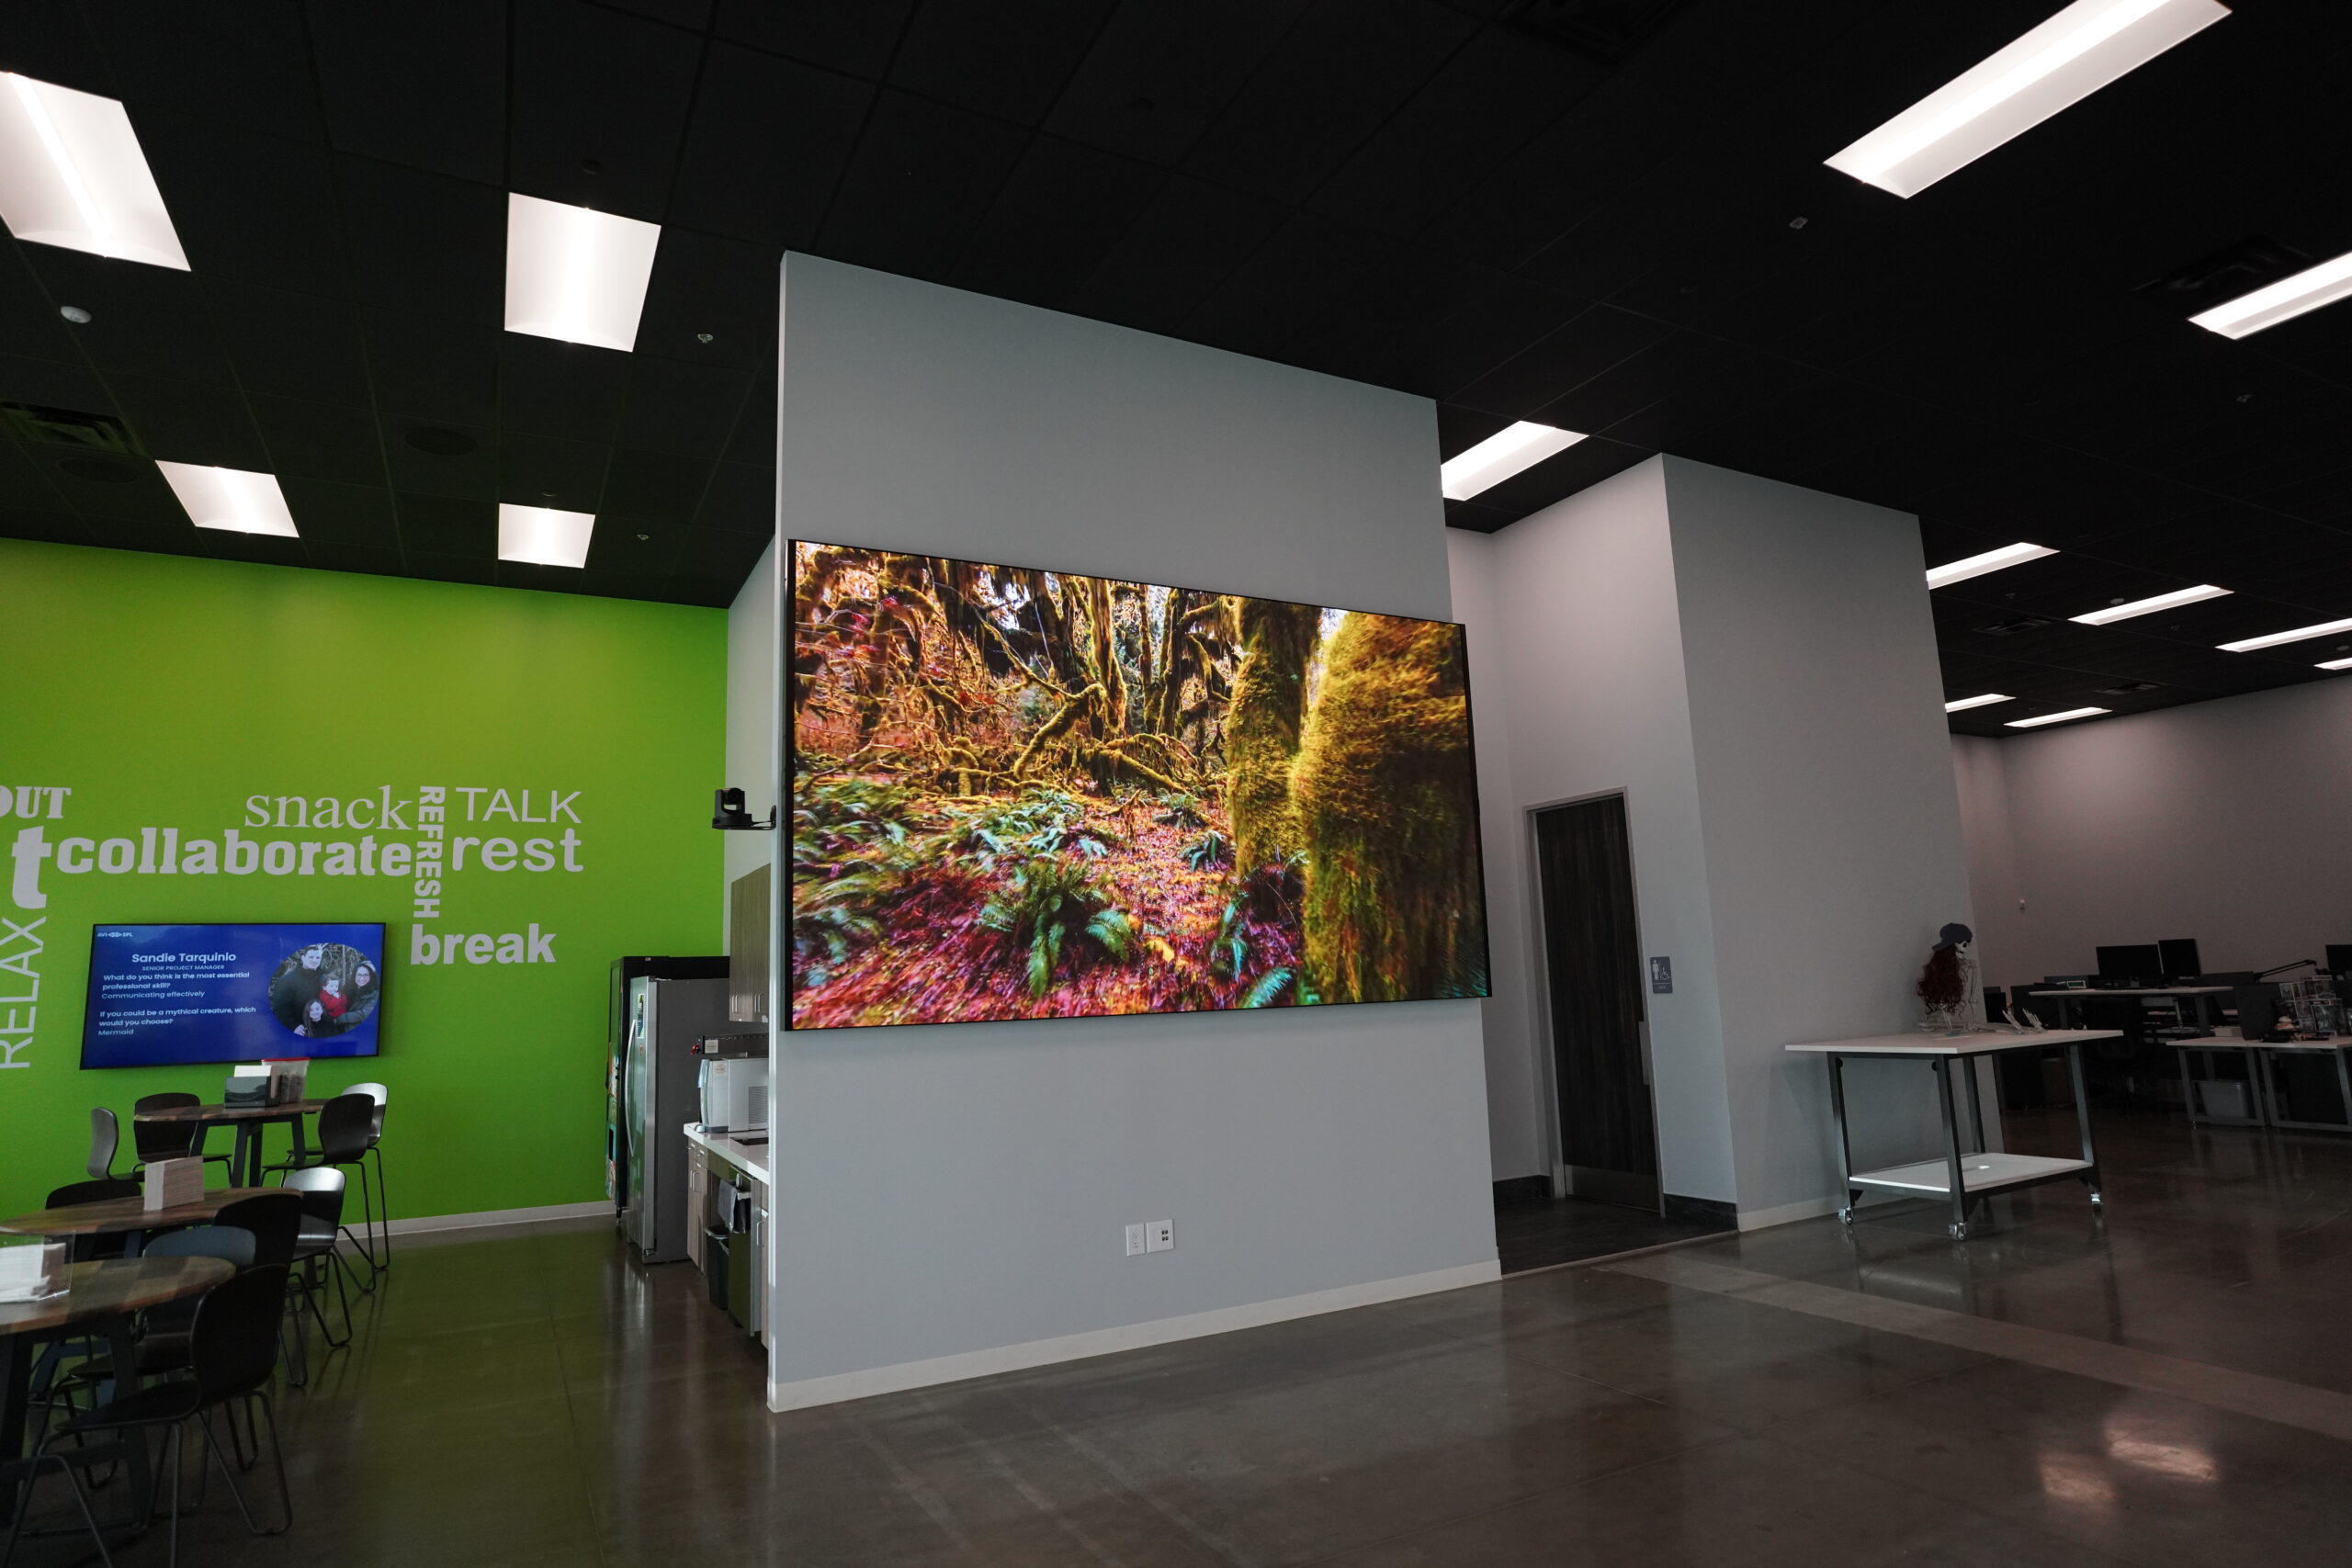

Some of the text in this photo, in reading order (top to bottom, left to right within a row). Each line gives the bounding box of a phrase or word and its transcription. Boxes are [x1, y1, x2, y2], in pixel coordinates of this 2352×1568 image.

[244, 784, 413, 830] snack
[455, 786, 583, 824] TALK
[56, 827, 412, 876] collaborate
[413, 785, 446, 919] REFRESH
[452, 828, 584, 873] rest
[131, 952, 237, 964] Sandie Tarquinio
[411, 923, 557, 965] break
[0, 917, 47, 1068] RELAX
[101, 990, 206, 999] Communicating effectively
[102, 982, 151, 991] professional
[138, 974, 153, 982] you
[164, 1008, 199, 1016] mythical
[97, 1028, 134, 1036] Mermaid
